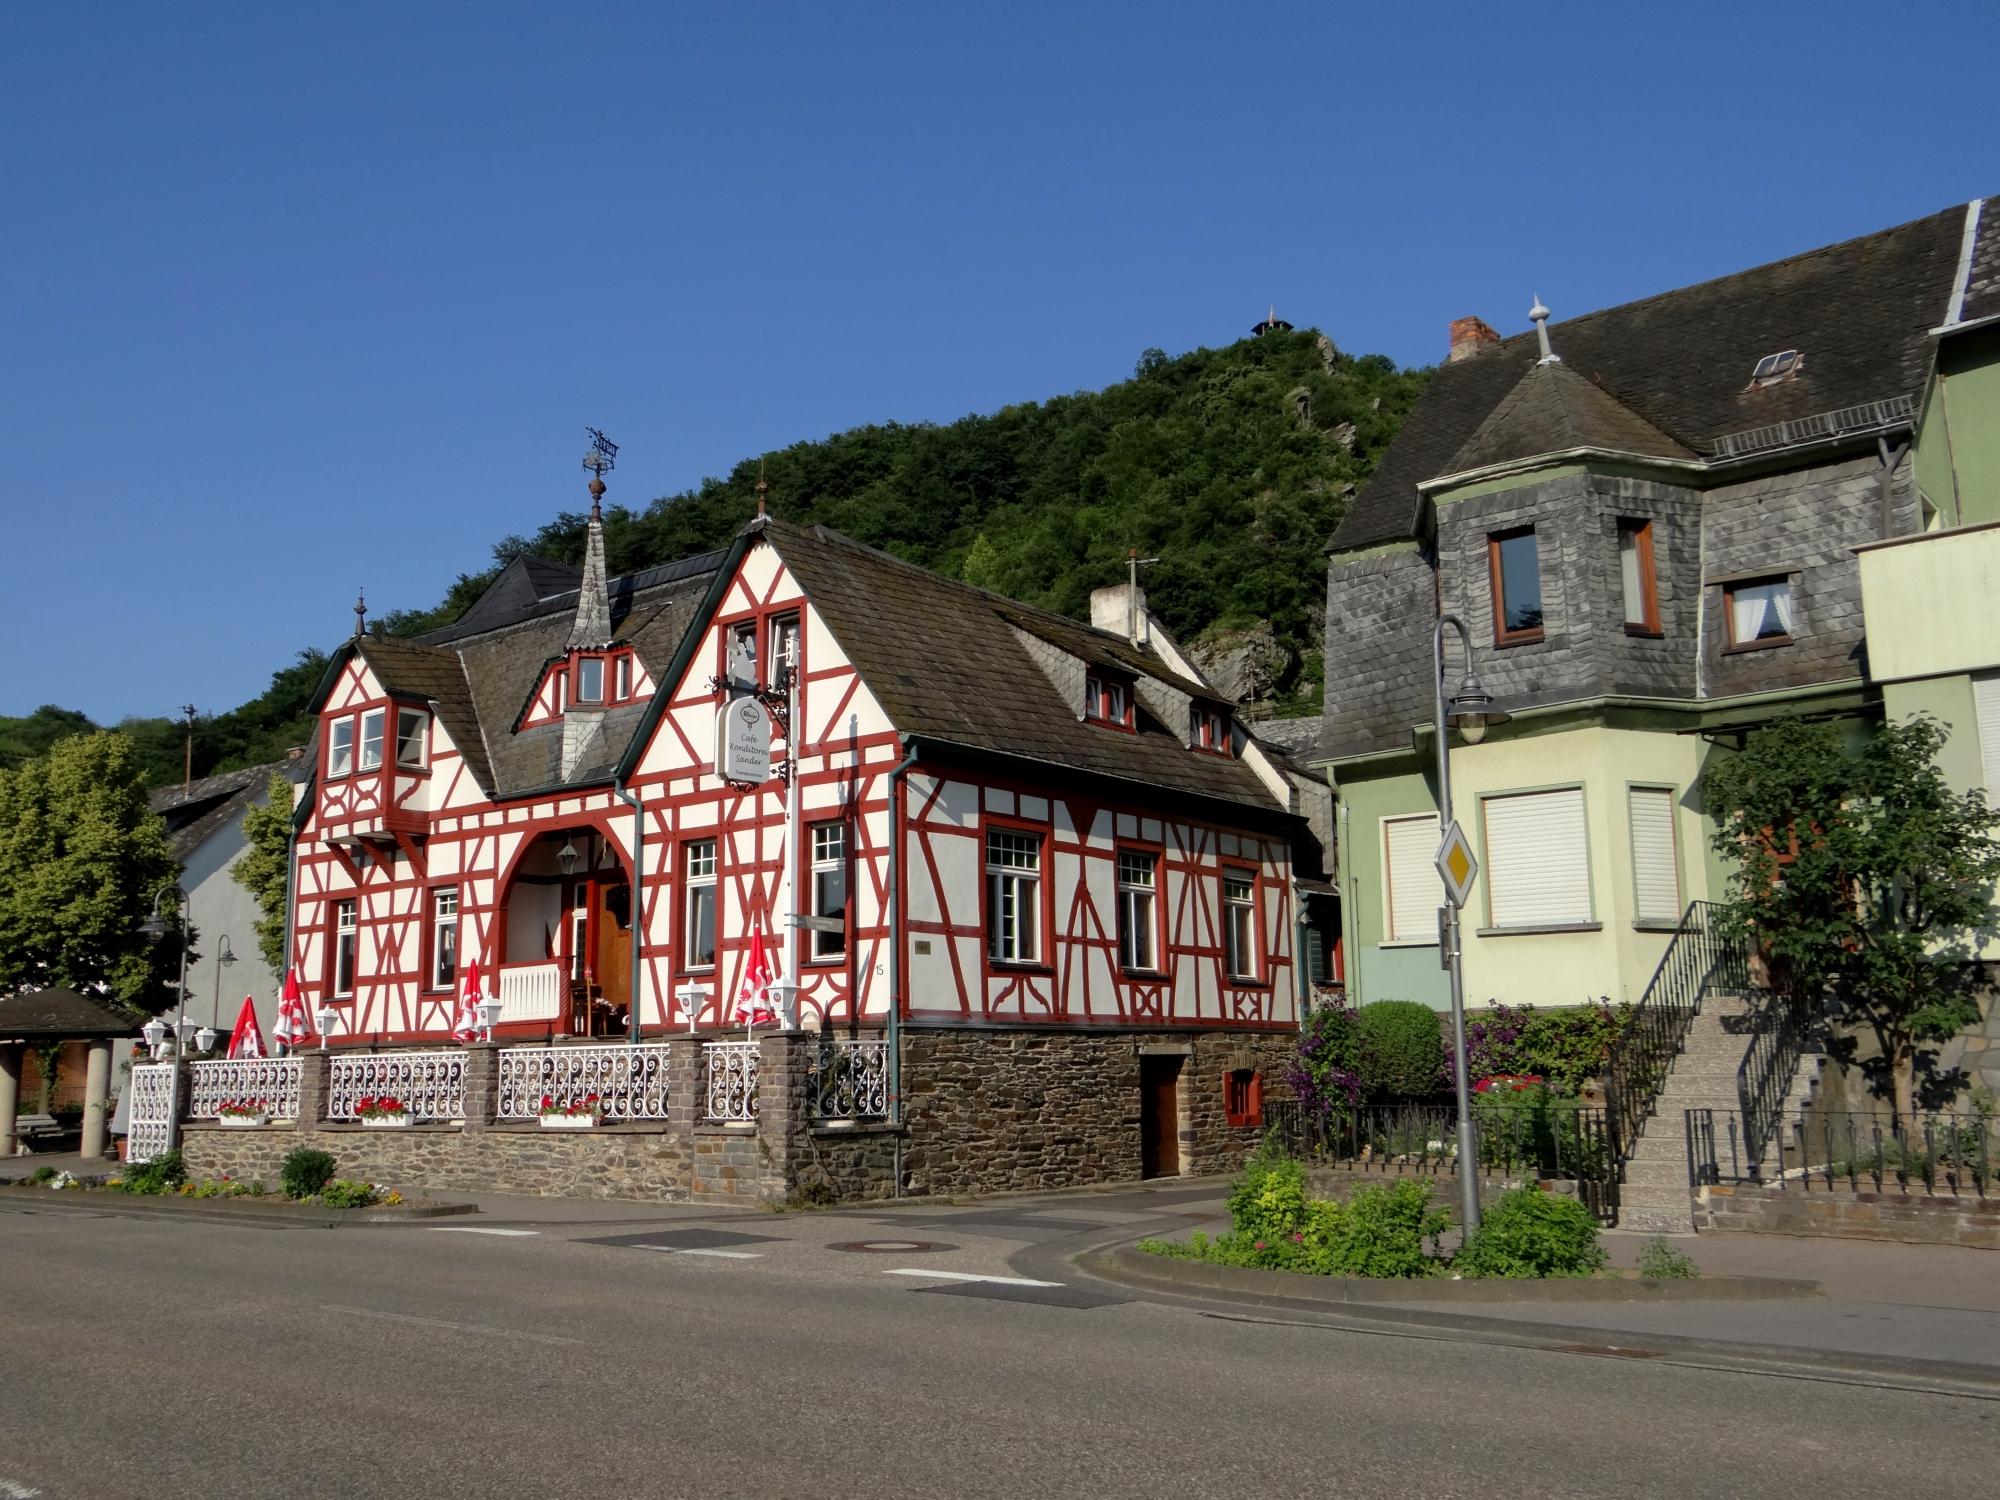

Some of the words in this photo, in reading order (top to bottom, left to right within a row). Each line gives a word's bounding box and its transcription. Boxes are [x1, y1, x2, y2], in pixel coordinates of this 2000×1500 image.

[729, 742, 768, 755] Konditorei
[735, 755, 762, 765] Sander
[875, 964, 884, 975] 15
